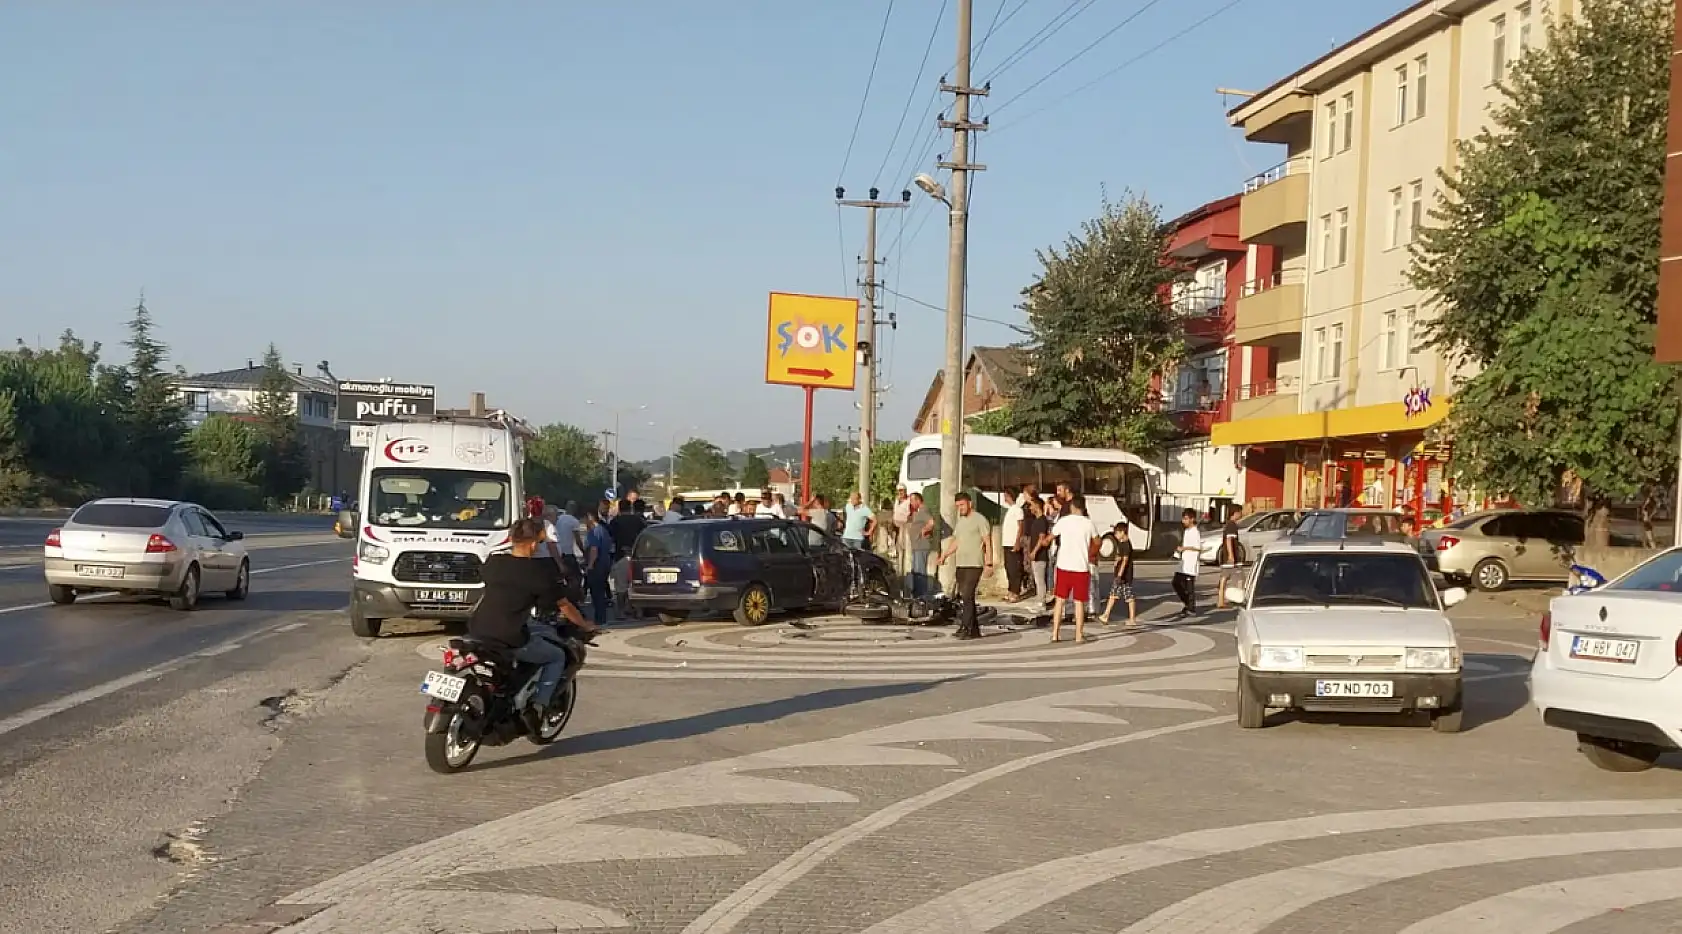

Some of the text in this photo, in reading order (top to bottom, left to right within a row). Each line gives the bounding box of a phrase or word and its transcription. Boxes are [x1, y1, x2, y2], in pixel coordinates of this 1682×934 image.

[777, 321, 848, 359] ŞOK
[395, 385, 433, 396] mobilya
[356, 398, 417, 419] puffu
[1403, 388, 1432, 421] ŞOK
[395, 444, 429, 454] 112
[1578, 640, 1636, 658] 34 HBY 047
[428, 672, 463, 690] 67ACC
[1324, 682, 1389, 695] 67 ND 703
